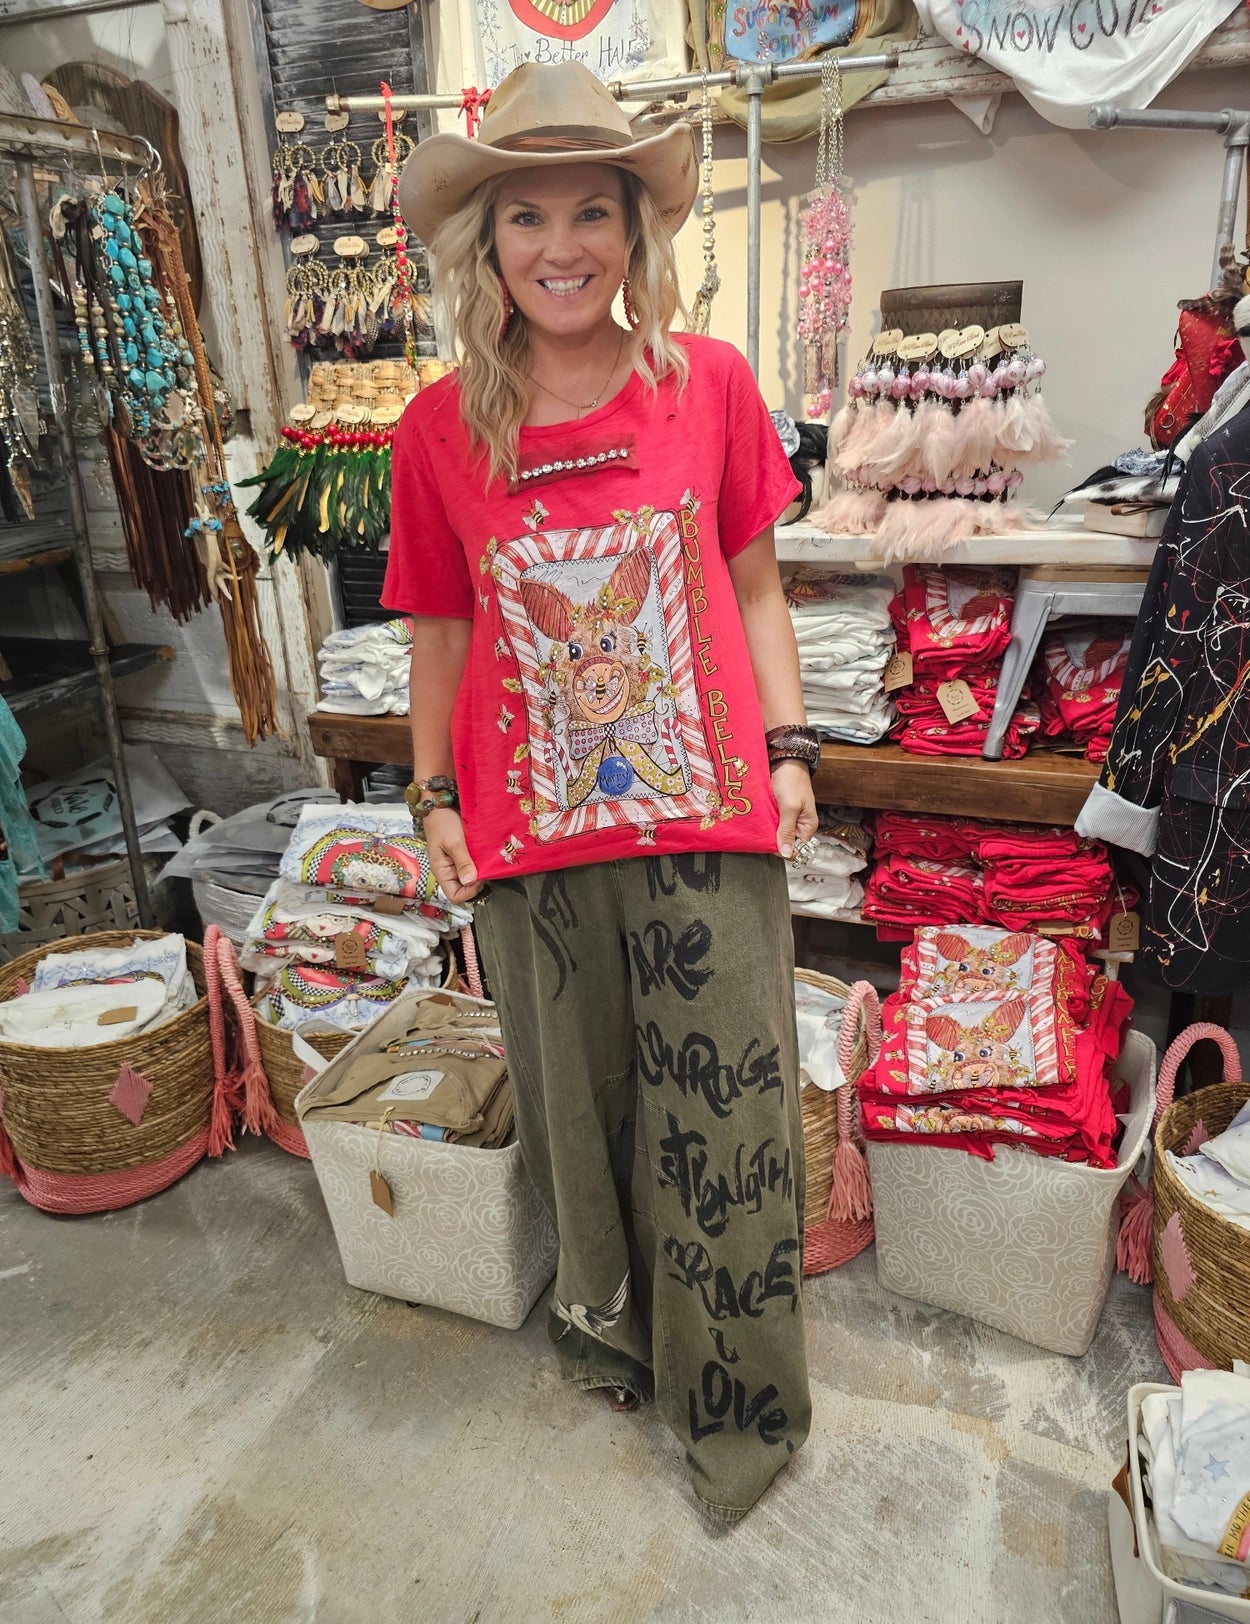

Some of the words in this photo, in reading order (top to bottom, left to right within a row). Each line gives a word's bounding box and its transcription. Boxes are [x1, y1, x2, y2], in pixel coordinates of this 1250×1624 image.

[756, 28, 818, 61] SOPHIE
[960, 4, 1065, 55] SNOW
[680, 509, 717, 677] BUMBLE
[707, 689, 752, 816] BELLS
[599, 771, 629, 789] Merry
